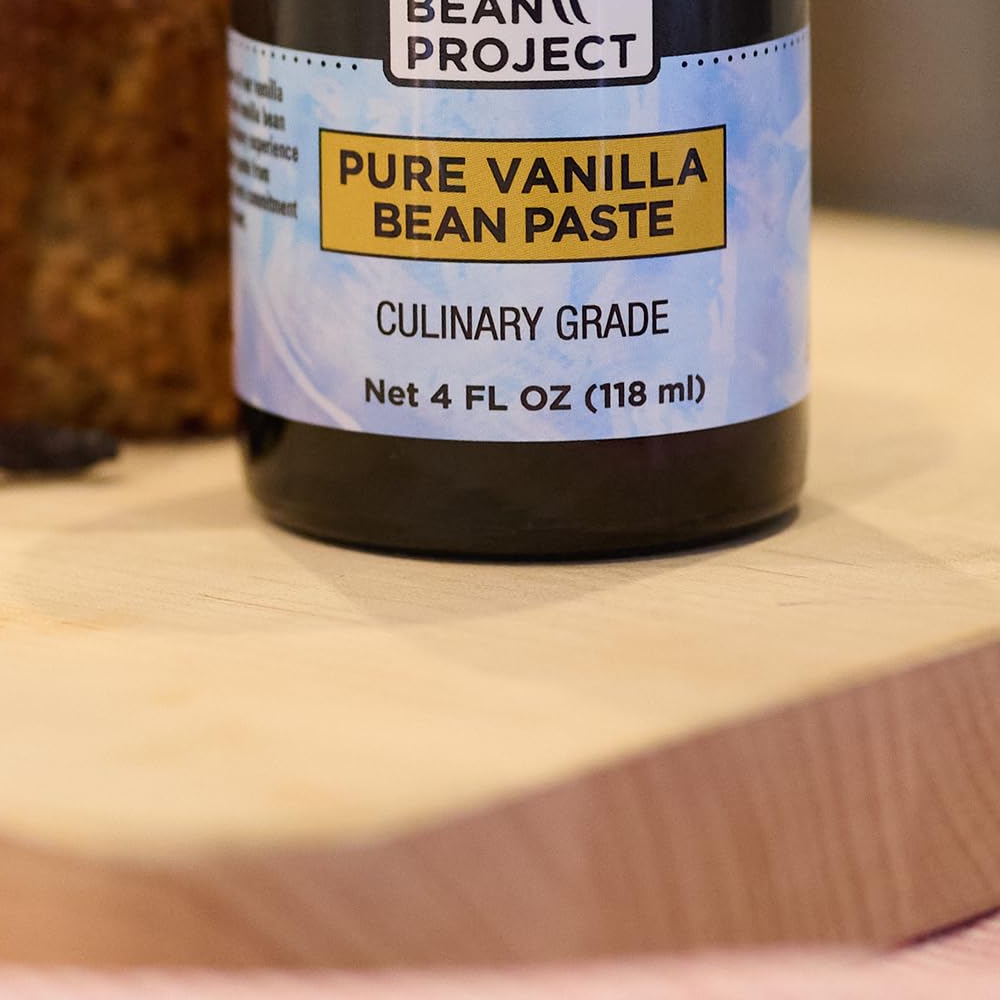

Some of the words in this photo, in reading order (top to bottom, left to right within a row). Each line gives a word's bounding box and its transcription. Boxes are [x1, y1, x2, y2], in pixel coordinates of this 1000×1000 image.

[408, 34, 637, 72] PROJECT
[339, 150, 467, 193] PURE
[487, 148, 708, 194] VANILLA
[374, 202, 506, 243] BEAN
[525, 200, 674, 243] PASTE
[377, 301, 543, 340] CULINARY
[557, 300, 669, 340] GRADE
[366, 378, 419, 407] Net
[431, 384, 452, 408] 4
[466, 385, 508, 410] FL
[521, 385, 572, 412] OZ
[585, 381, 647, 413] (118
[659, 374, 706, 405] ml)
